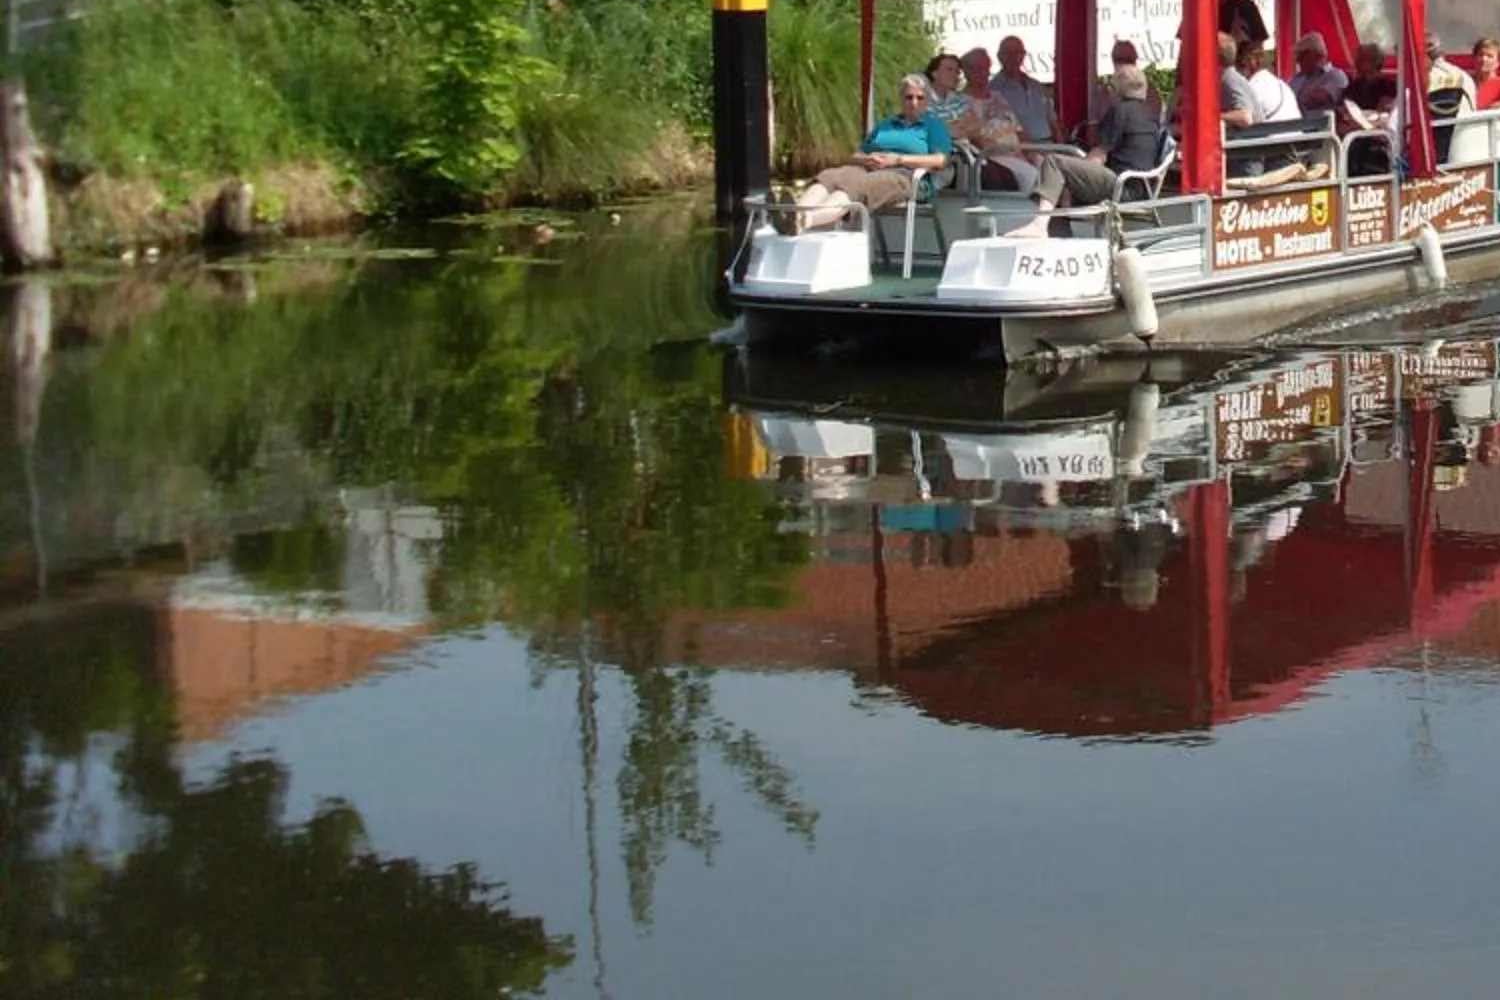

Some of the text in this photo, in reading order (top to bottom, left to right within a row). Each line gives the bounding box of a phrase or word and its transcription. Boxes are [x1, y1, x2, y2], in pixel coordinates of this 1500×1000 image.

[1006, 3, 1041, 28] und
[1348, 184, 1385, 211] Lübz
[1216, 196, 1309, 235] Christine
[1215, 236, 1264, 267] HOTEL
[1273, 226, 1333, 259] Restaurant
[1018, 251, 1103, 277] RZ-AD 91
